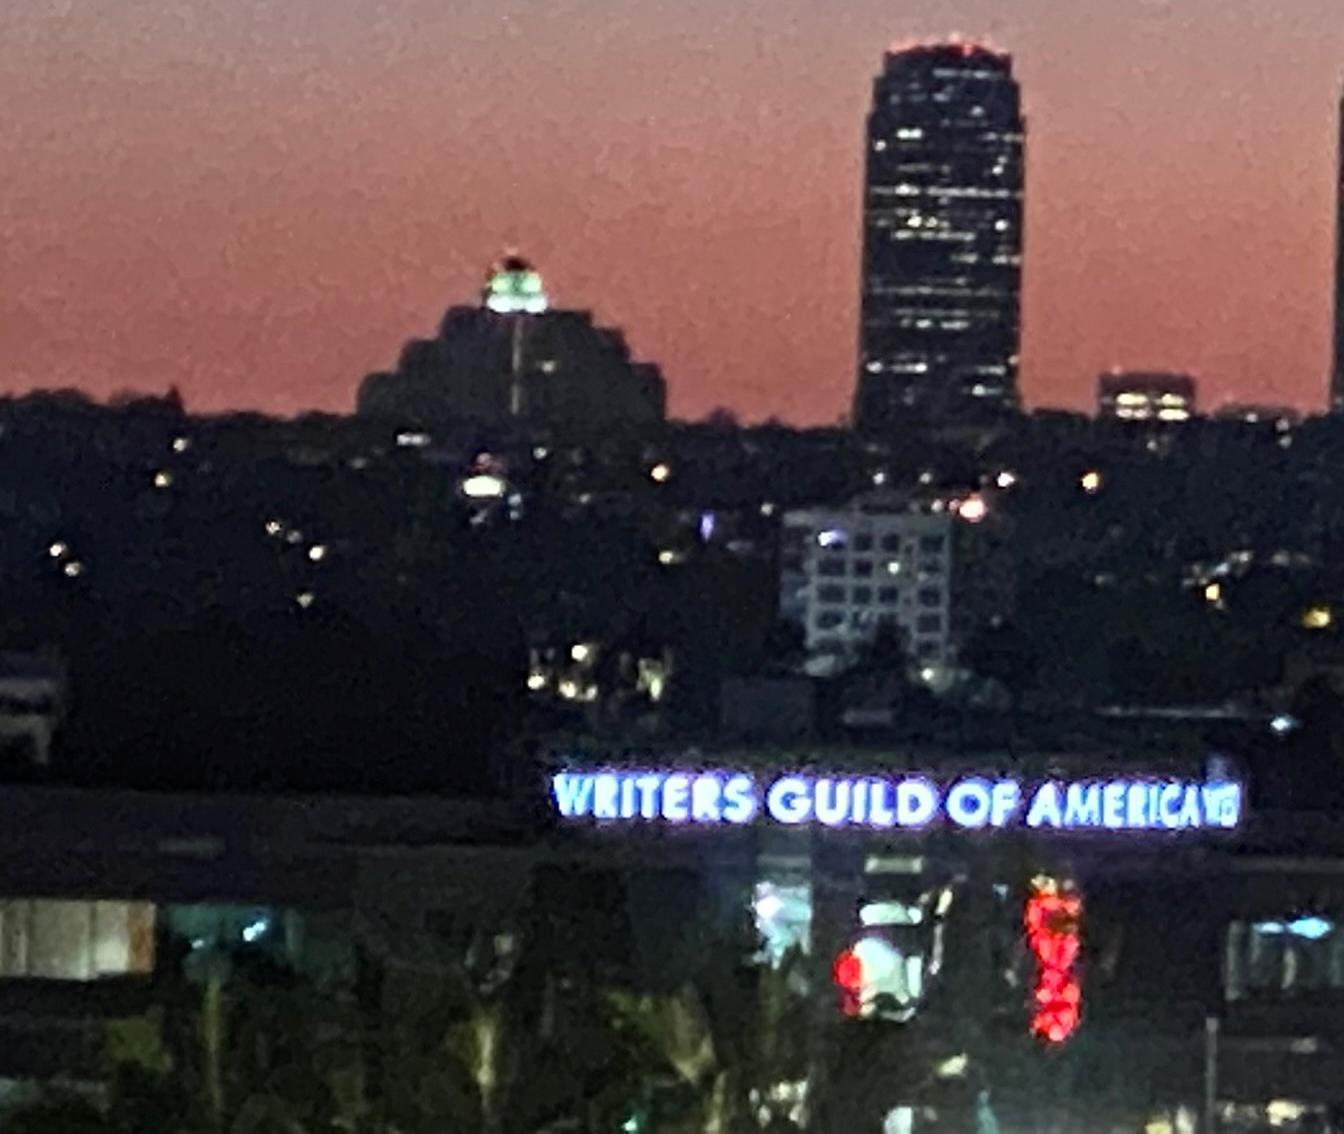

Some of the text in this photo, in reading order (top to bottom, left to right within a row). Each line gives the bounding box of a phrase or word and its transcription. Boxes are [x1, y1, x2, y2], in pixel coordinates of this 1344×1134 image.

[554, 772, 755, 822] WRITERS
[767, 776, 937, 826] GUILD
[945, 776, 1020, 827] OF
